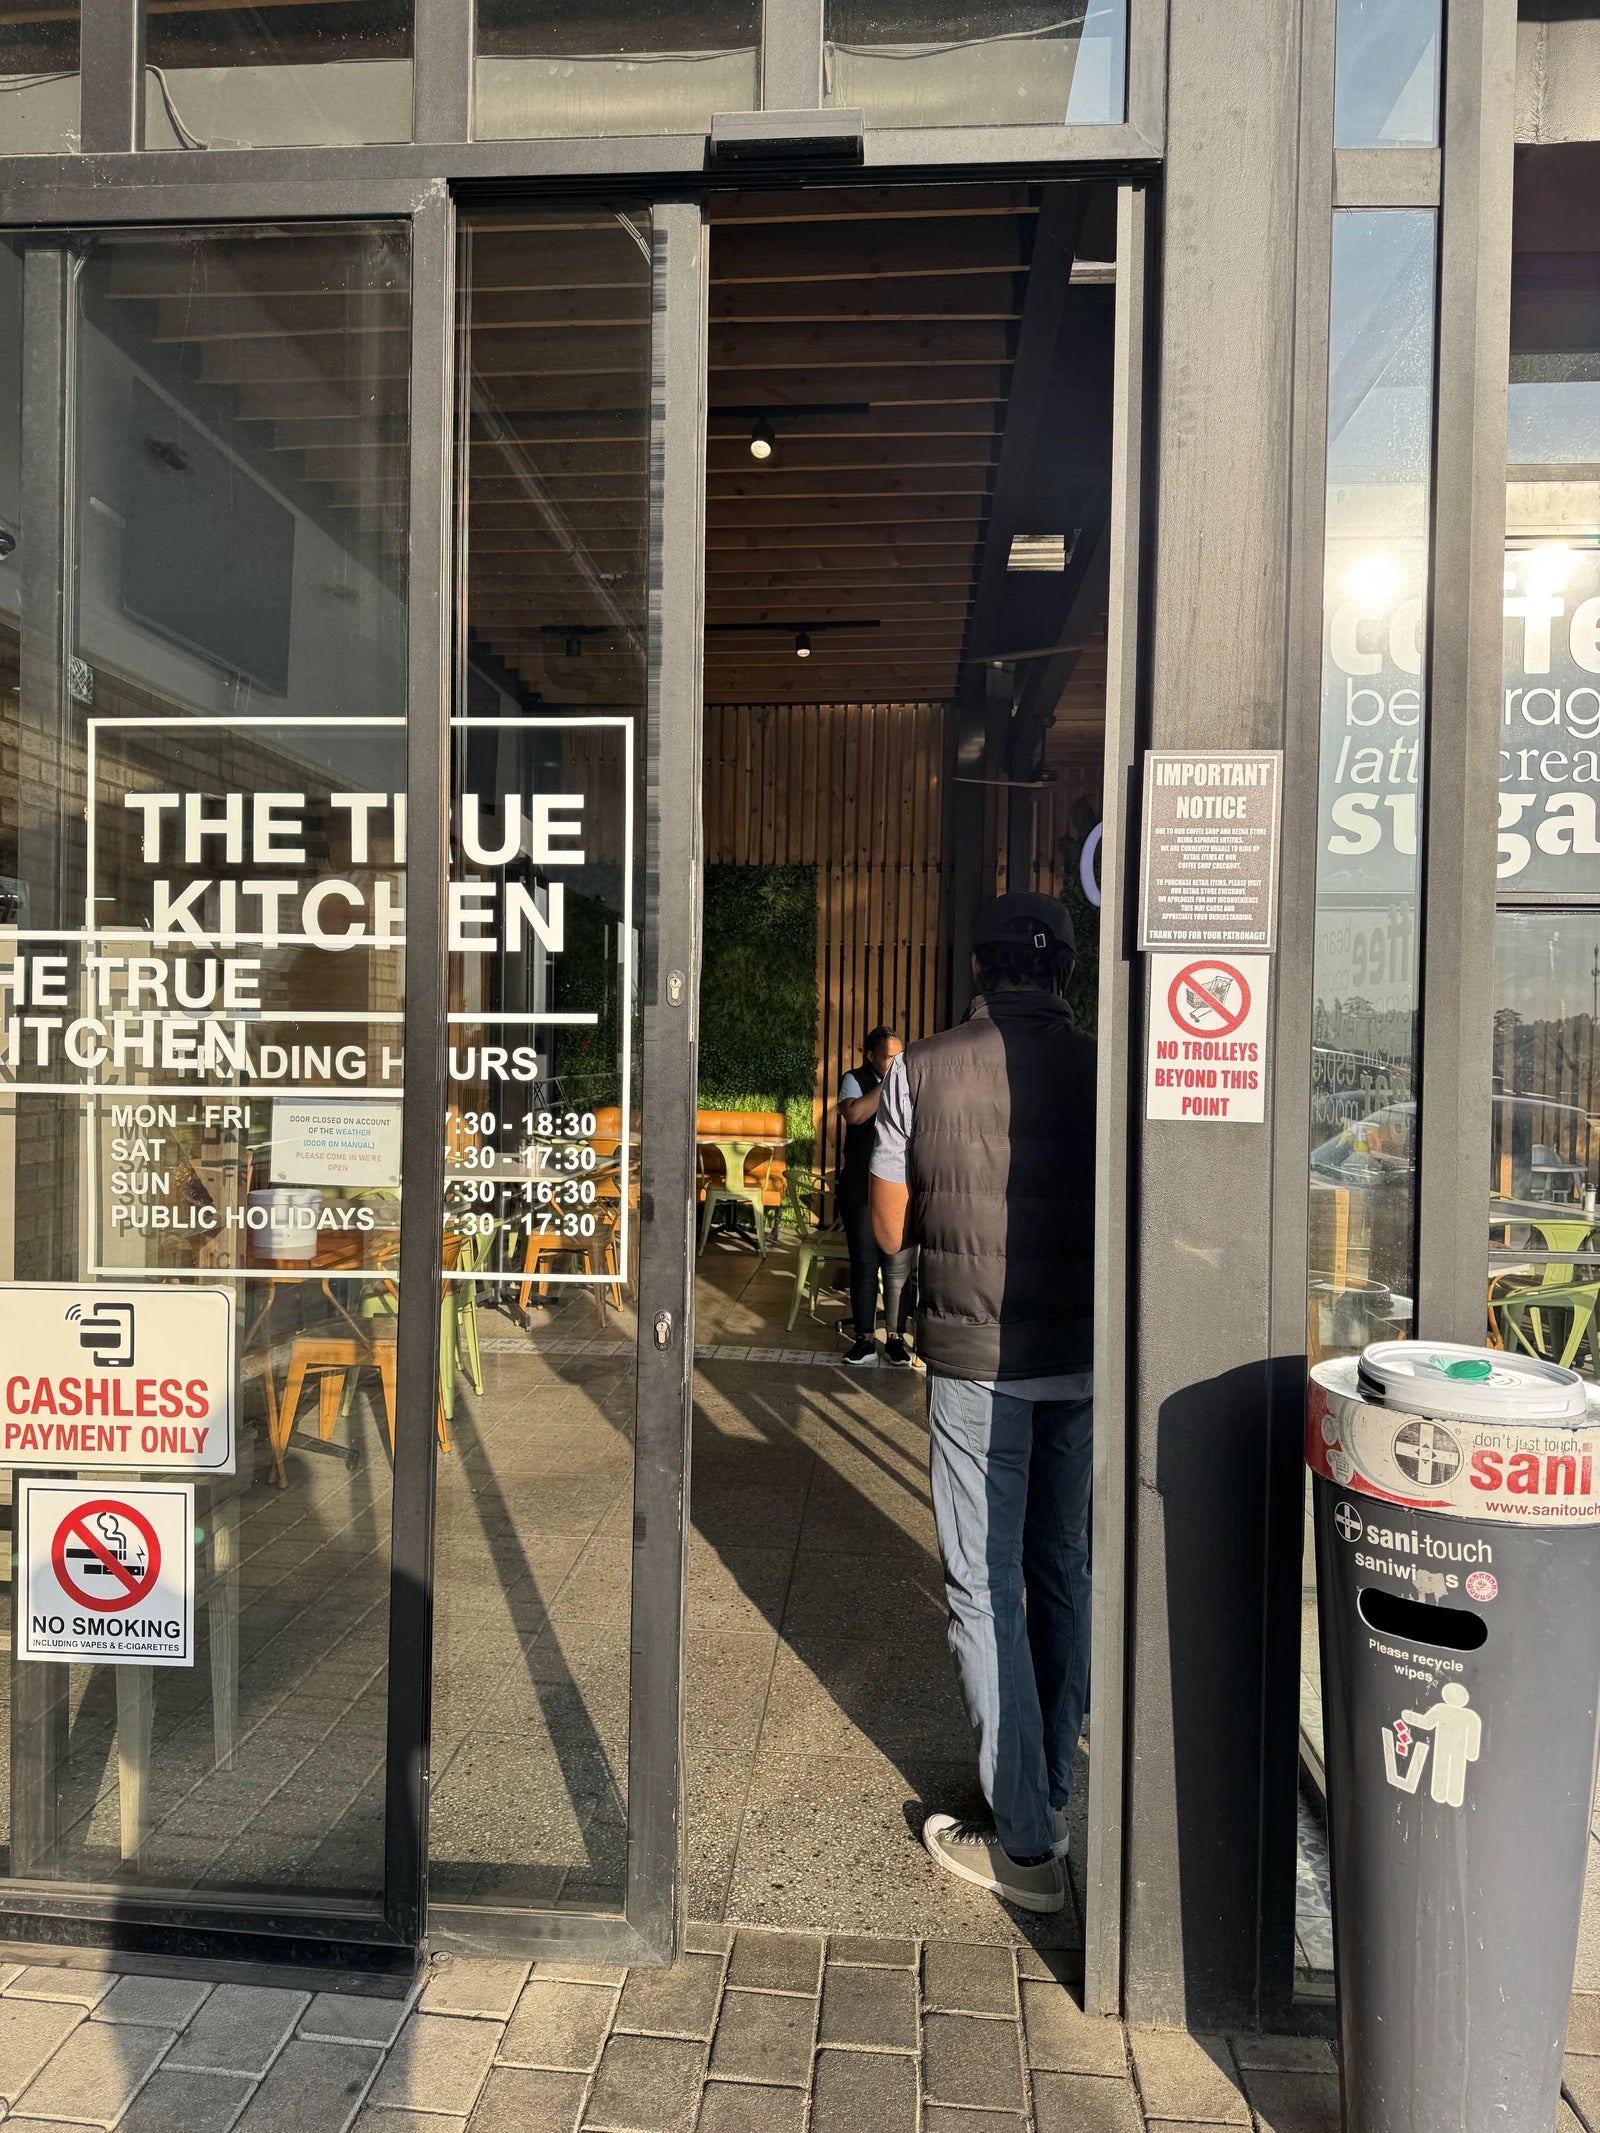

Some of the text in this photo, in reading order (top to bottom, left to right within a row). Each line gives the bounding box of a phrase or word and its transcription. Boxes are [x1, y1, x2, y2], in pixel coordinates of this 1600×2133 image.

[1156, 763, 1270, 786] IMPORTANT
[1176, 795, 1247, 819] NOTICE
[124, 793, 586, 865] THE TUE
[1149, 930, 1266, 940] THANK YOU FOR YOUR PATRONAGE!
[85, 957, 261, 1008] TRUE
[0, 1017, 246, 1069] ITCHEN
[1157, 1040, 1258, 1062] NO TROLLEYS
[172, 1045, 538, 1081] TRADING HURS
[1155, 1068, 1258, 1090] BEYOND THIS
[111, 1104, 176, 1128] MON
[205, 1105, 250, 1129] FRI
[1181, 1096, 1230, 1116] POINT
[289, 1115, 391, 1126] DOOR CLOSED ON ACCOUNT
[320, 1127, 334, 1135] THE
[335, 1128, 371, 1136] WEATHER
[521, 1112, 597, 1136] 18:30
[110, 1138, 166, 1162] SAT
[303, 1139, 375, 1149] (DOOR ON MANUAL)
[296, 1152, 325, 1160] PLEASE
[326, 1153, 347, 1161] COME
[358, 1154, 382, 1162] WE'RE
[521, 1146, 597, 1170] 17:30
[110, 1171, 170, 1195] SUN
[520, 1180, 596, 1204] 16:30
[111, 1205, 375, 1232] PUBLIC HOLIDAYS
[520, 1213, 596, 1237] 17:30
[6, 1375, 210, 1419] CASHLESS
[5, 1423, 210, 1454] PAYMENT ONLY
[1474, 1433, 1511, 1449] don't
[1469, 1442, 1593, 1496] sani
[1485, 1501, 1600, 1516] www.sanitouch
[1366, 1524, 1493, 1564] sani-touch
[1354, 1552, 1459, 1588] saniwis
[32, 1615, 181, 1639] NO SMOKING
[33, 1639, 78, 1648] INCLUDING
[80, 1640, 108, 1649] VAPES
[118, 1642, 180, 1652] E-CIGARETTES
[1369, 1638, 1464, 1672] Please recycle
[1394, 1664, 1434, 1683] wipes
